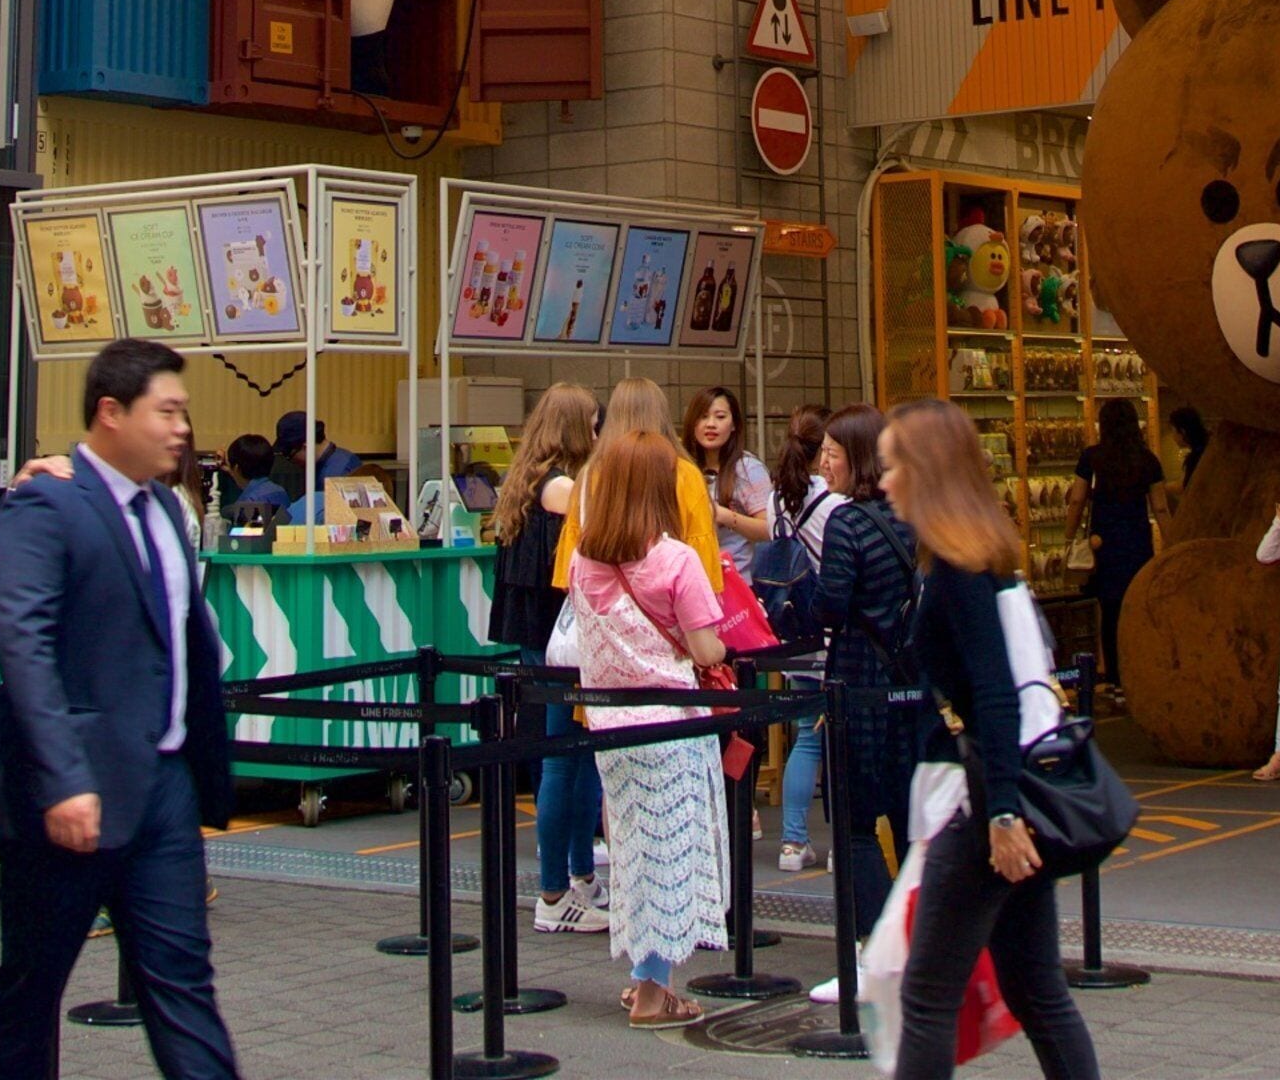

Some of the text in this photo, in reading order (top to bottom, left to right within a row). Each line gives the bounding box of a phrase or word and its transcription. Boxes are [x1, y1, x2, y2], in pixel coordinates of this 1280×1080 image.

[788, 230, 824, 249] STAIRS
[713, 607, 750, 637] Factory
[887, 691, 906, 703] LINE
[360, 707, 382, 717] LINE
